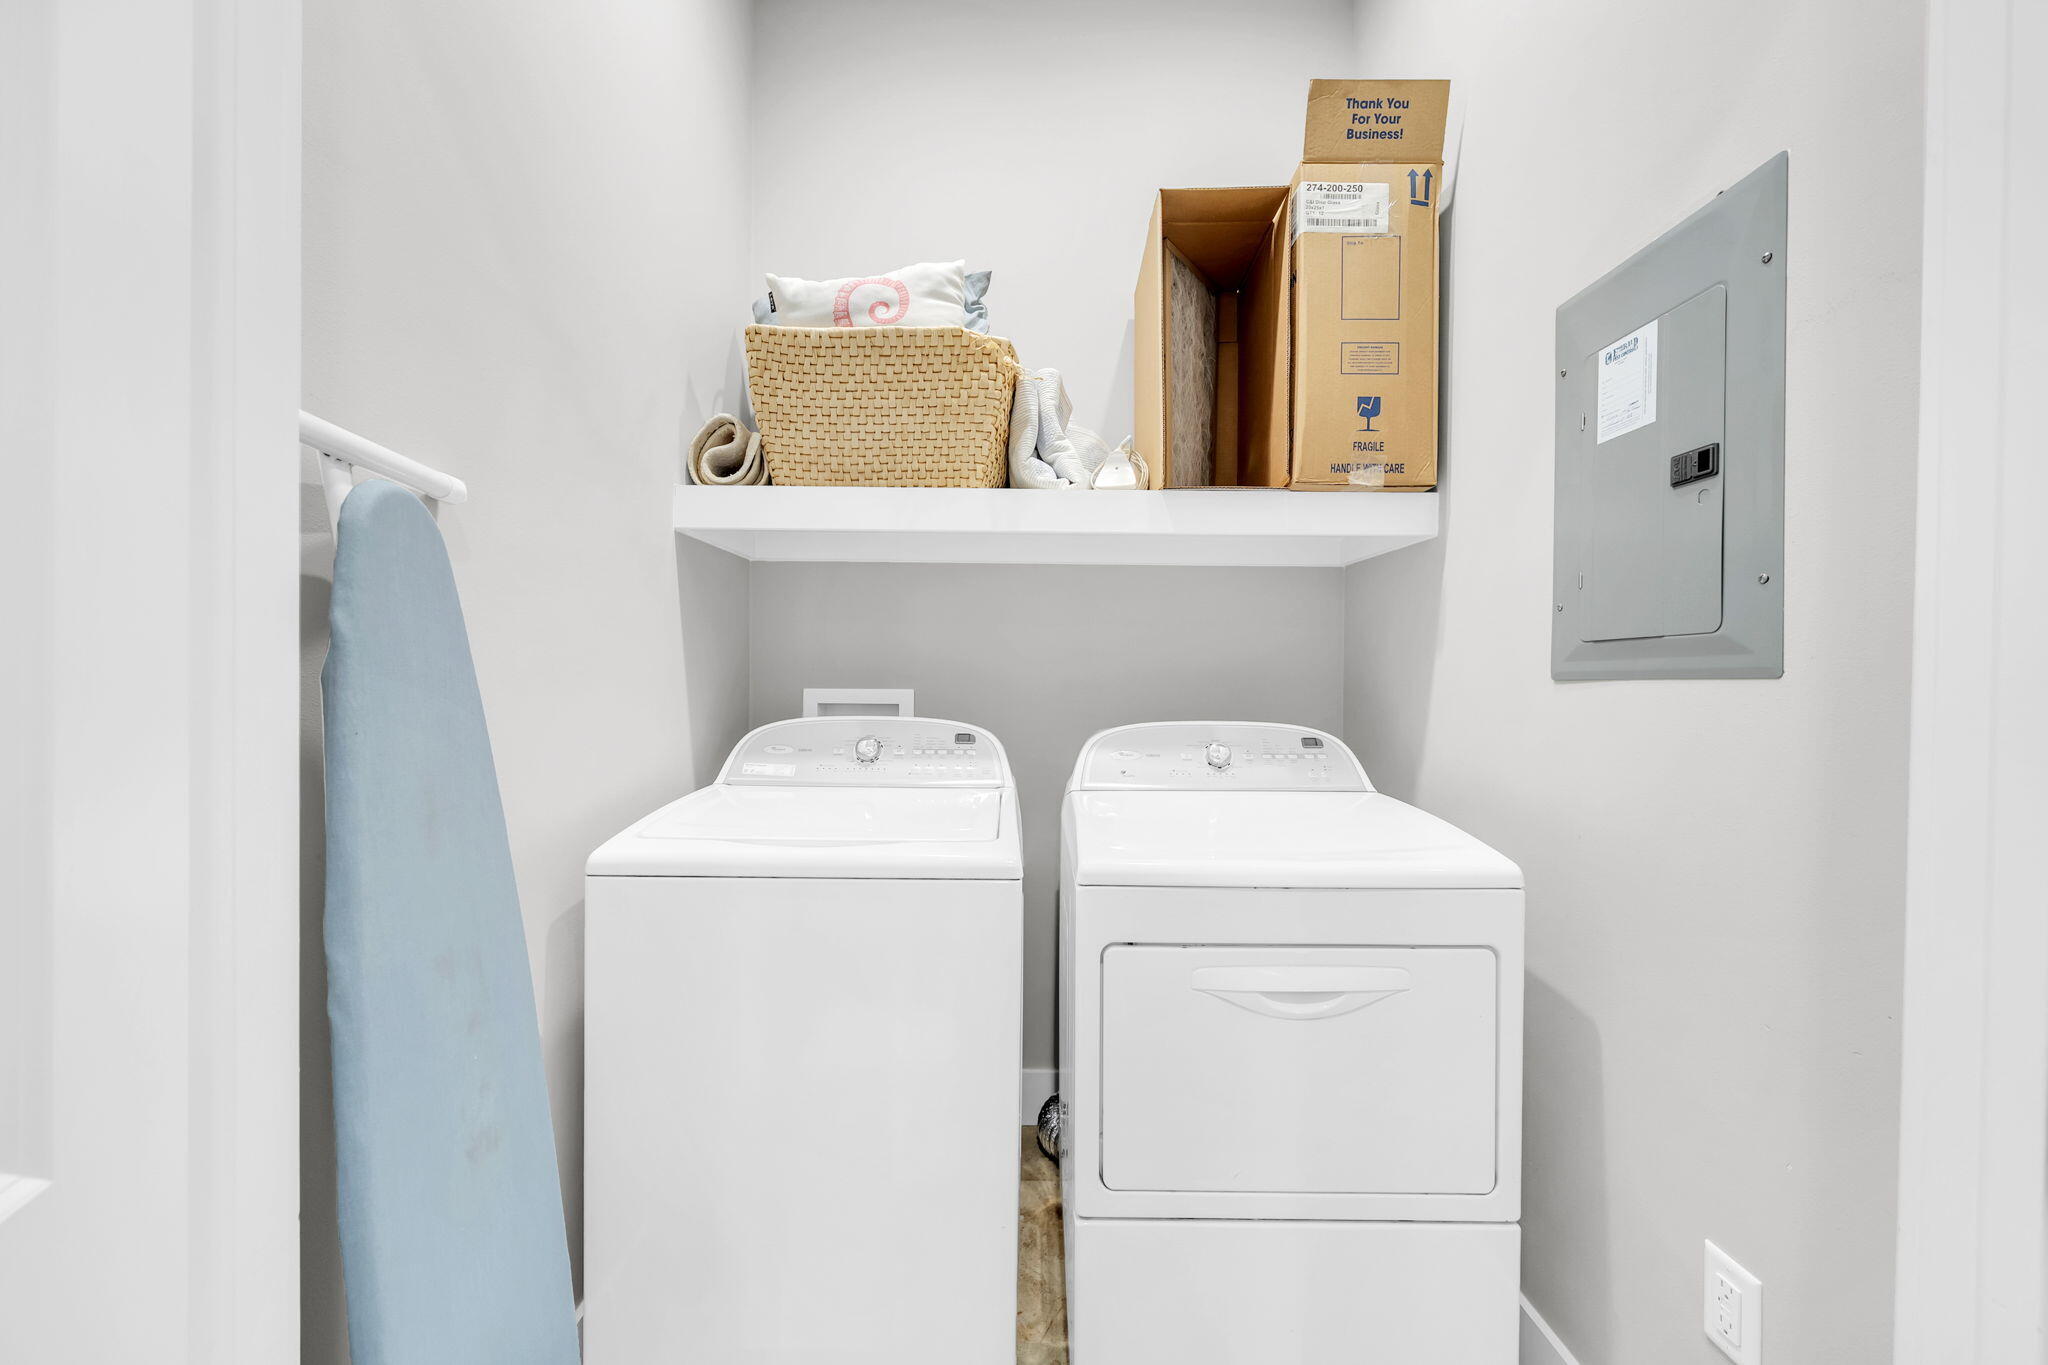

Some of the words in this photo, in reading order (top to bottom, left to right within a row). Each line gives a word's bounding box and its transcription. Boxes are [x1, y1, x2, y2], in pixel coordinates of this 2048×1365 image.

[1346, 98, 1383, 109] Thank
[1387, 98, 1410, 109] You
[1352, 113, 1371, 124] For
[1374, 113, 1401, 125] Your
[1346, 128, 1404, 140] Business!
[1306, 183, 1364, 193] 274-200-250
[1353, 441, 1384, 452] FRAGILE
[1384, 463, 1405, 474] CARE
